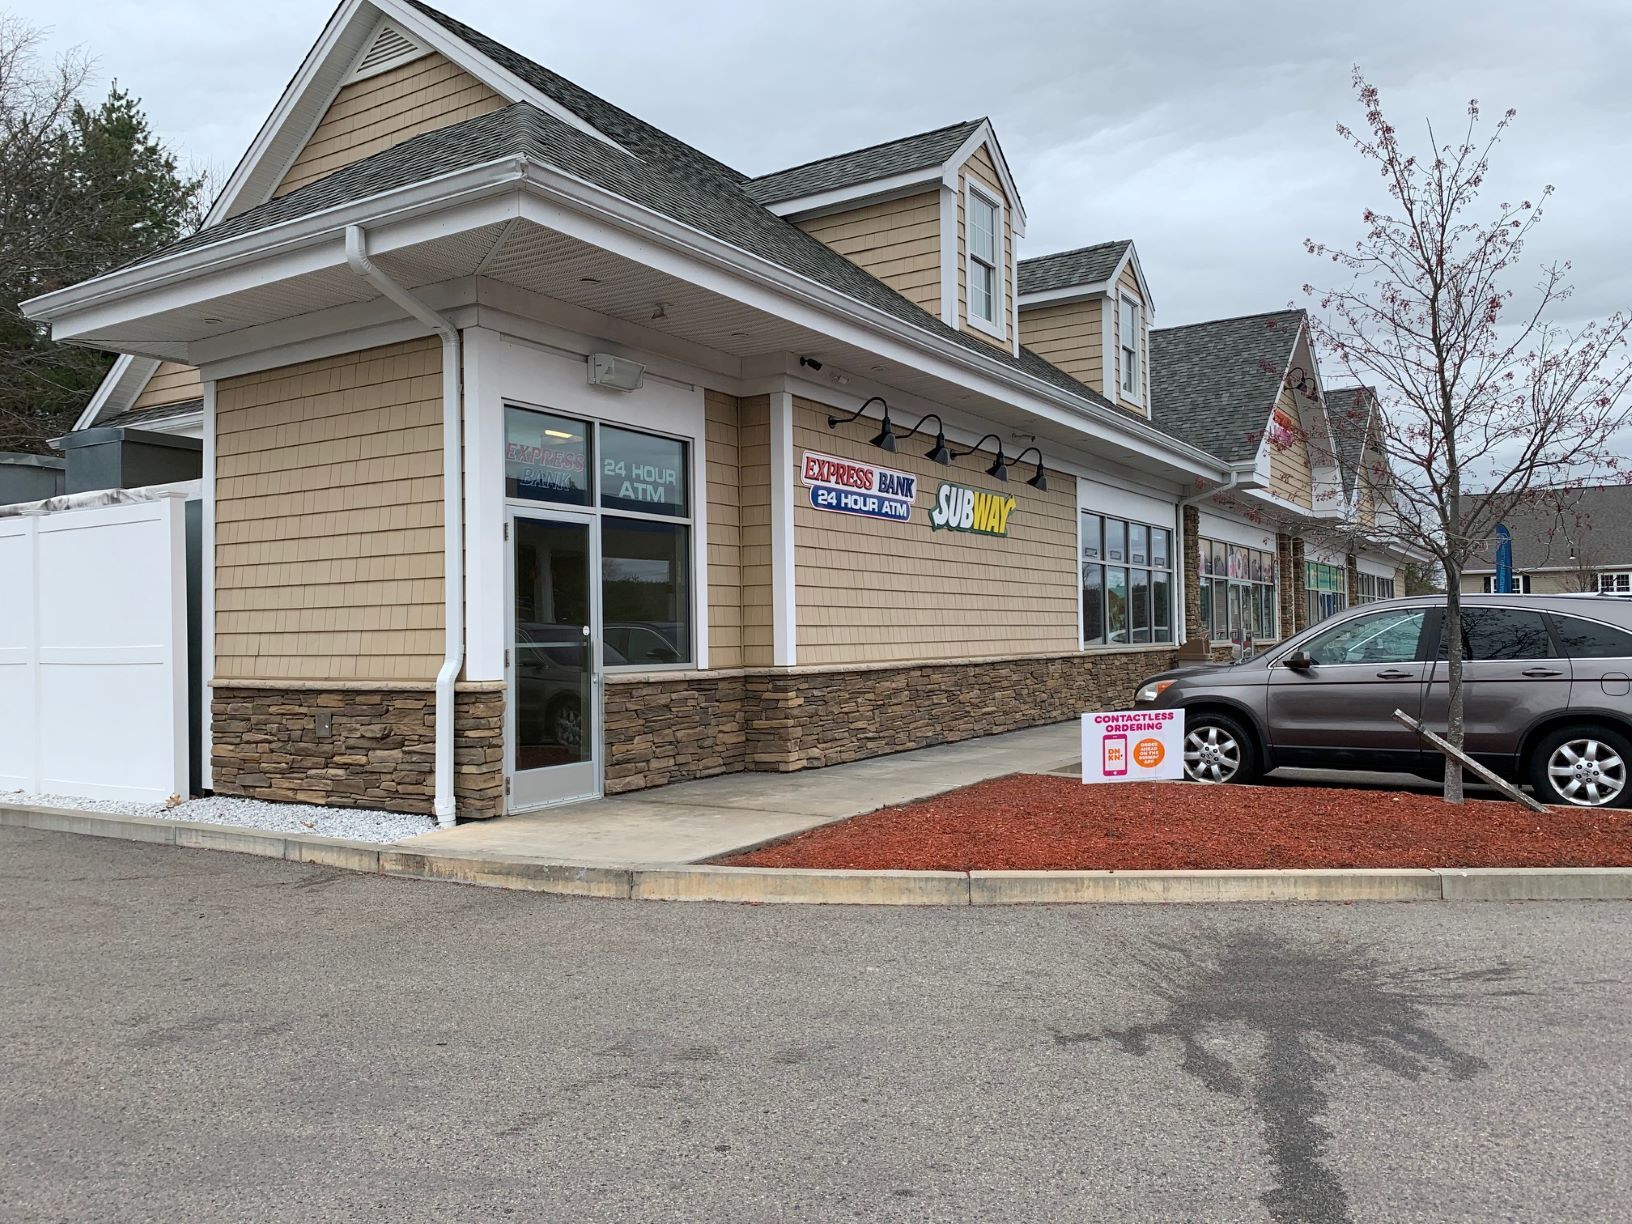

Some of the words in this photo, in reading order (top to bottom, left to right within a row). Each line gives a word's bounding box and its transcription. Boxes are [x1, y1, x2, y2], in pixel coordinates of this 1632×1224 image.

[505, 442, 585, 472] EXPRESS
[520, 468, 572, 492] BANK
[604, 458, 627, 478] 24
[632, 463, 677, 486] HOUR
[804, 456, 874, 491] EXPRESS
[878, 472, 915, 499] BANK
[619, 481, 665, 504] ATM
[817, 489, 838, 506] 24
[840, 493, 879, 513] HOUR
[881, 500, 907, 517] ATM
[932, 483, 1017, 534] SUBWAY
[1094, 712, 1174, 724] CONTACTLESS
[1105, 722, 1163, 733] ORDERING
